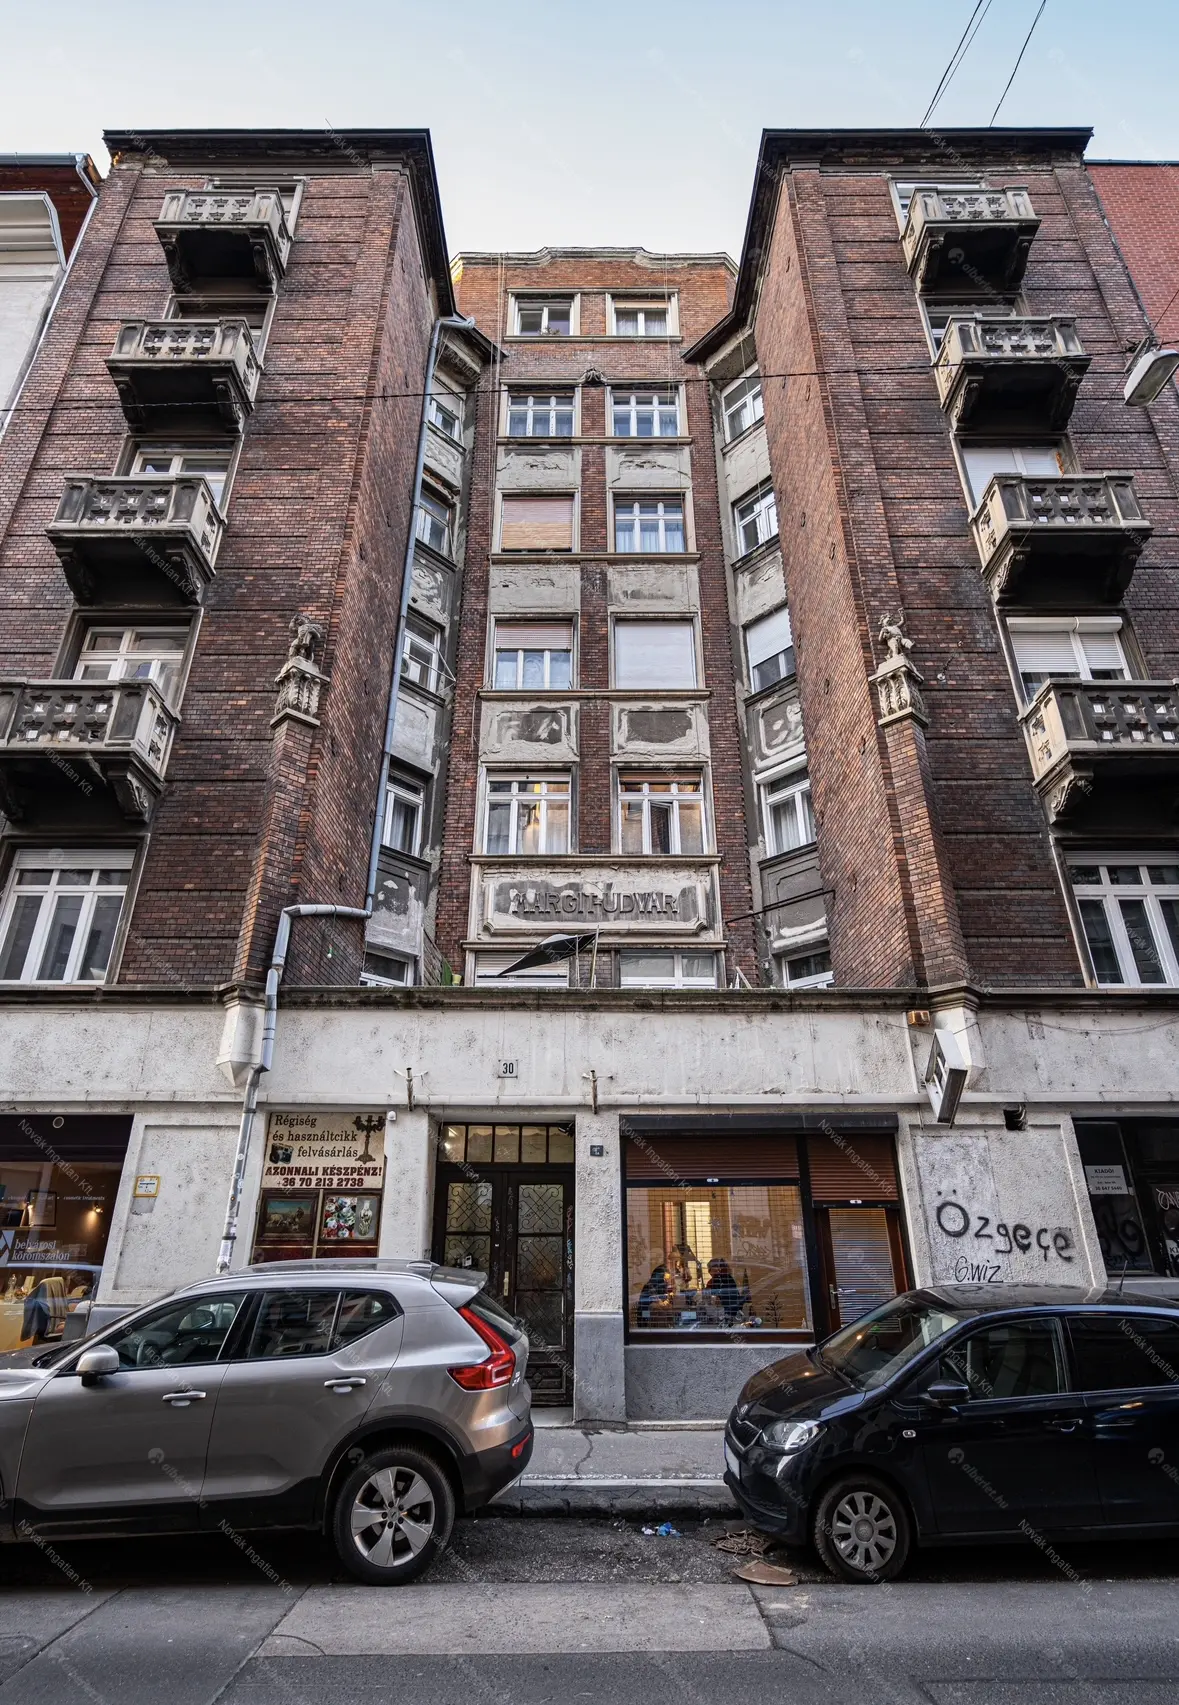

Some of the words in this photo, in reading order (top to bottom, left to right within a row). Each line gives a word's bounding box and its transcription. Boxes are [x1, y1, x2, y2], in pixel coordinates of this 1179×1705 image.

[502, 1062, 514, 1074] 30
[275, 1114, 317, 1128] Régiség
[272, 1131, 284, 1141] és
[288, 1130, 358, 1142] használtcikk
[297, 1146, 358, 1157] felvásárlás
[265, 1166, 319, 1176] AZONNALI
[322, 1165, 382, 1176] KÉSZPÉNZ!
[299, 1178, 312, 1187] 70
[315, 1178, 334, 1187] 213
[336, 1178, 364, 1187] 2738
[15, 1239, 56, 1250] belvárosi
[12, 1250, 70, 1260] körömszalon
